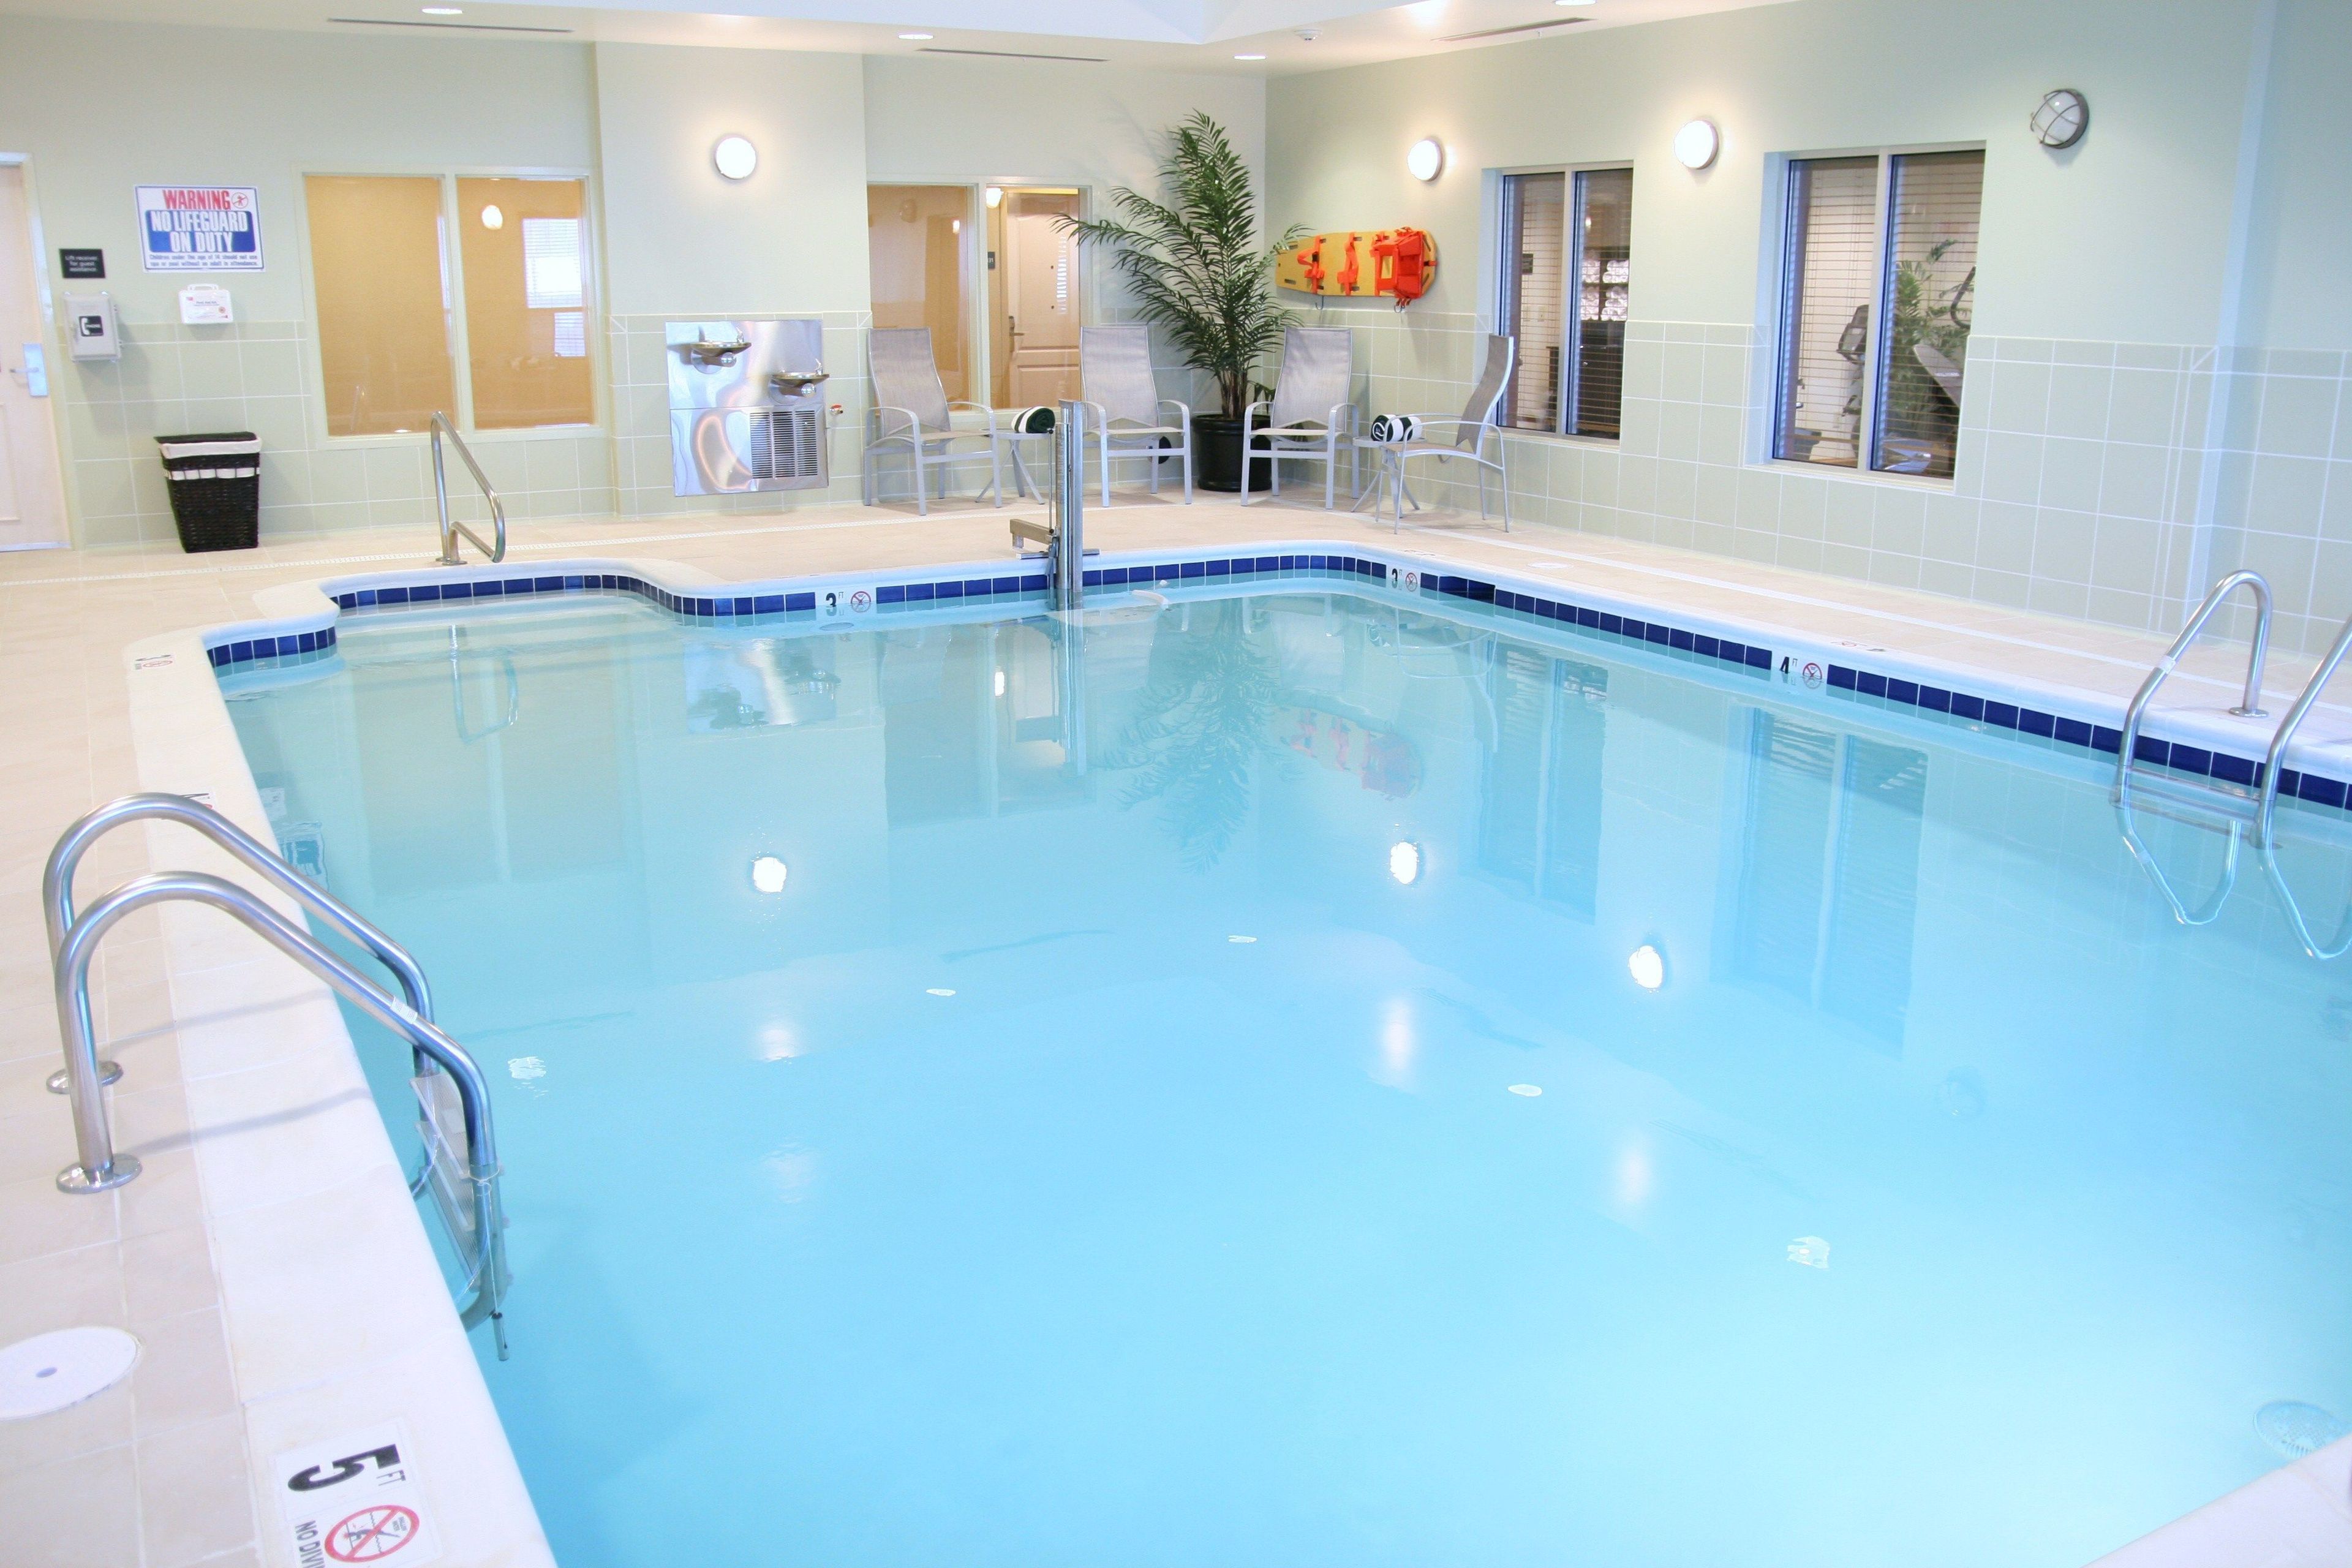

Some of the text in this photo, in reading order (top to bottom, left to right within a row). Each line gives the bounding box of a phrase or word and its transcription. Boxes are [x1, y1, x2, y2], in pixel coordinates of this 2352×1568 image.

[162, 189, 231, 209] WARNING
[151, 211, 248, 232] NO LIFEGUARD
[170, 232, 233, 252] ON DUTY
[287, 1443, 406, 1491] 5 FT
[295, 1520, 326, 1568] NO DIVI
